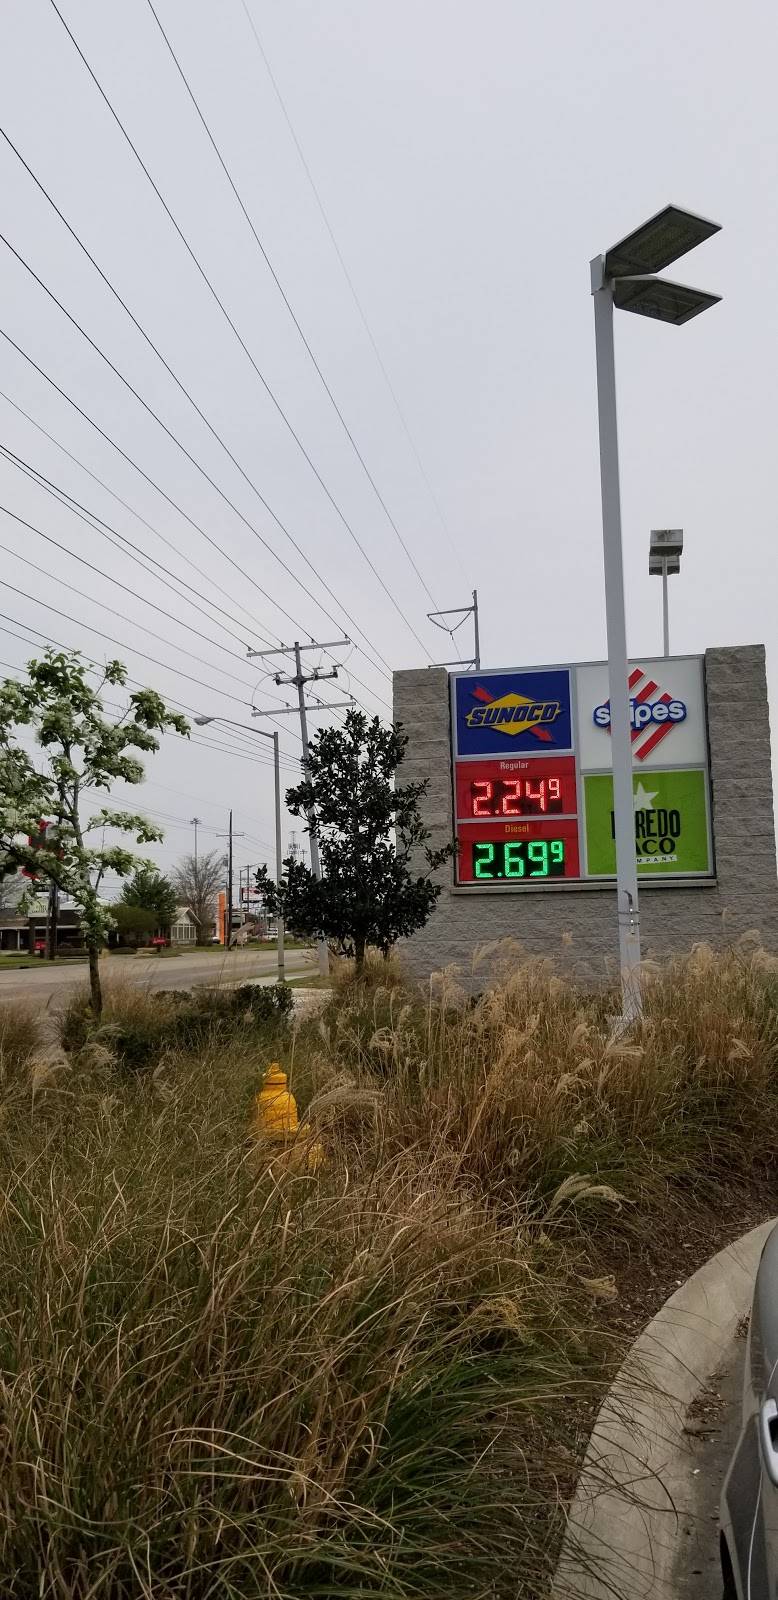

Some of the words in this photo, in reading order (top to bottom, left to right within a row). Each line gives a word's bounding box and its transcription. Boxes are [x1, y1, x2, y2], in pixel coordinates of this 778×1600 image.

[471, 704, 558, 724] SUNOCO
[595, 700, 684, 728] sipes
[500, 761, 529, 770] Regular
[504, 824, 530, 833] Diesel
[611, 809, 680, 839] REDO
